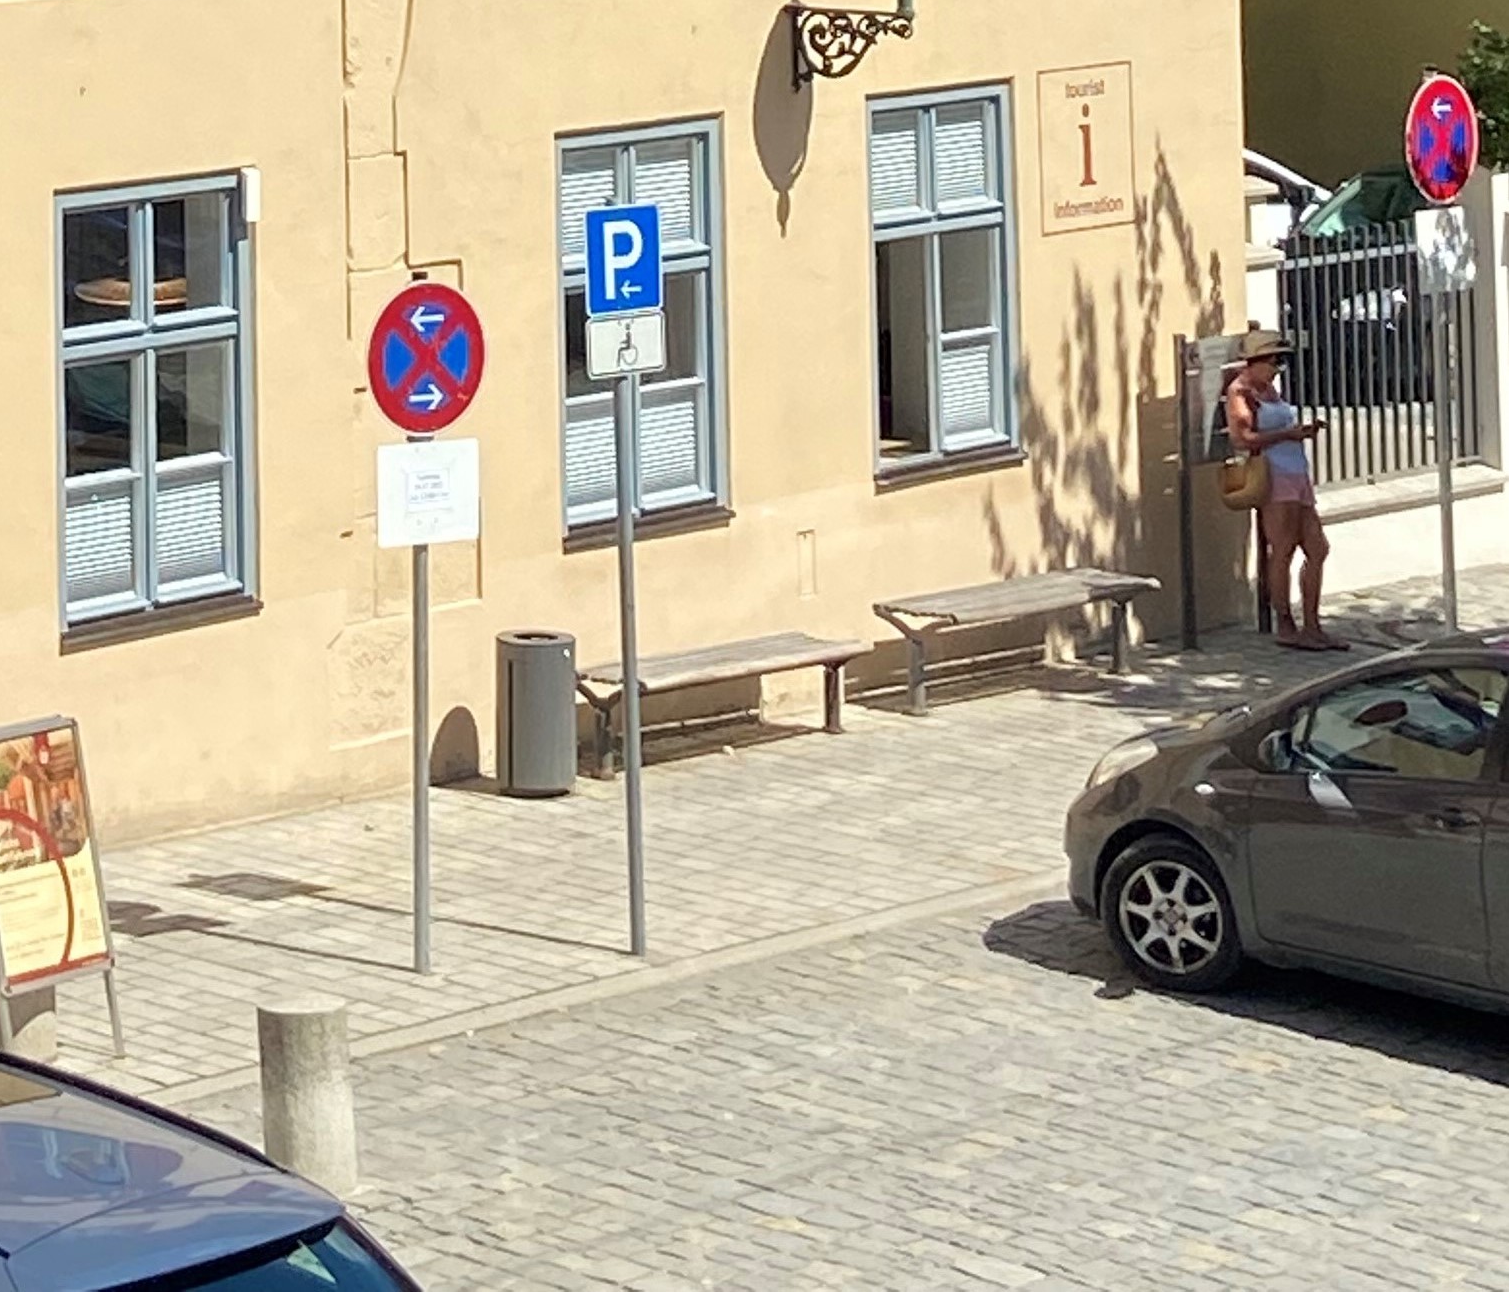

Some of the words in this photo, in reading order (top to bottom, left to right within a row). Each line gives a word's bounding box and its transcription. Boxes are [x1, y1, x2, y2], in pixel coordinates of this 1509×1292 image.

[1065, 79, 1105, 98] tourist
[1078, 103, 1097, 187] i
[1054, 197, 1124, 219] information
[603, 220, 644, 300] P
